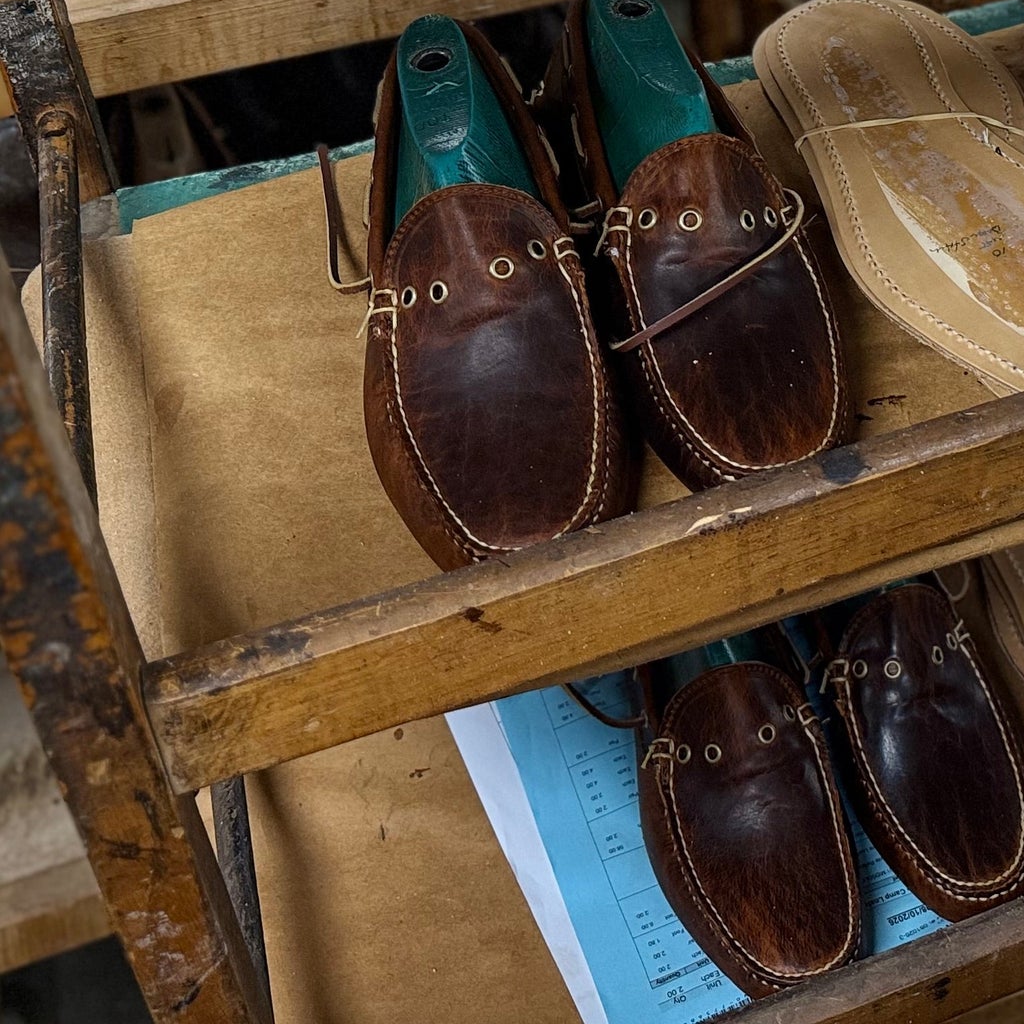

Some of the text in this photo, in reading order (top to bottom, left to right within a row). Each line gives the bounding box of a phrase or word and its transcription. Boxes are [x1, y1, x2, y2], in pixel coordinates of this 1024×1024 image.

[885, 888, 906, 900] Camp
[655, 959, 710, 985] Unit Quantity
[667, 970, 720, 997] Each 2.00
[673, 980, 722, 1004] Unit Qty
